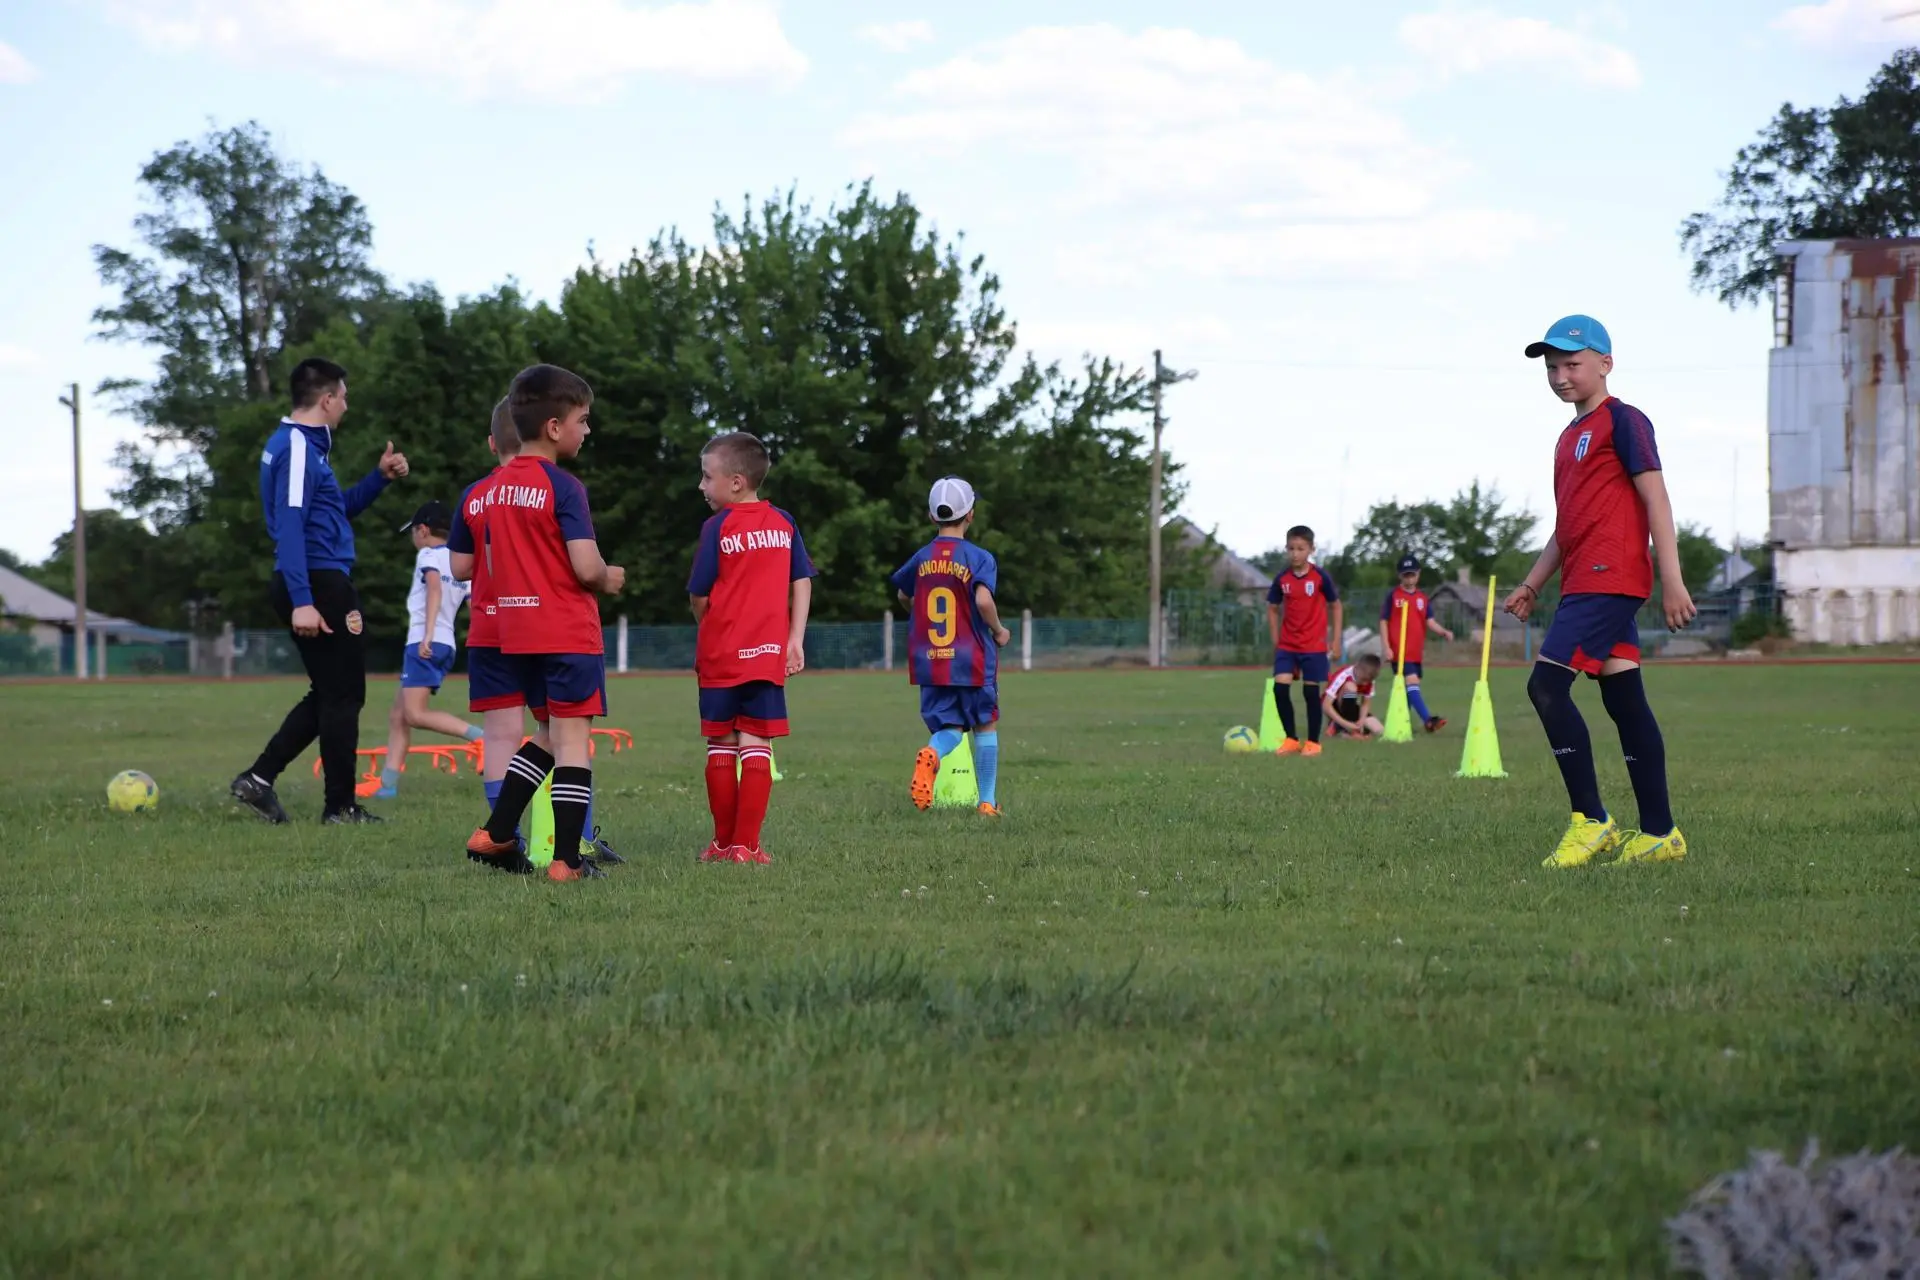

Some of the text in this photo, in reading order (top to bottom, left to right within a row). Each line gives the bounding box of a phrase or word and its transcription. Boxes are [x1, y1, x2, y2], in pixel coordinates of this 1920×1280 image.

[498, 485, 548, 510] АТАМАН
[720, 529, 792, 555] ФК АТАМАН
[927, 587, 957, 647] 9
